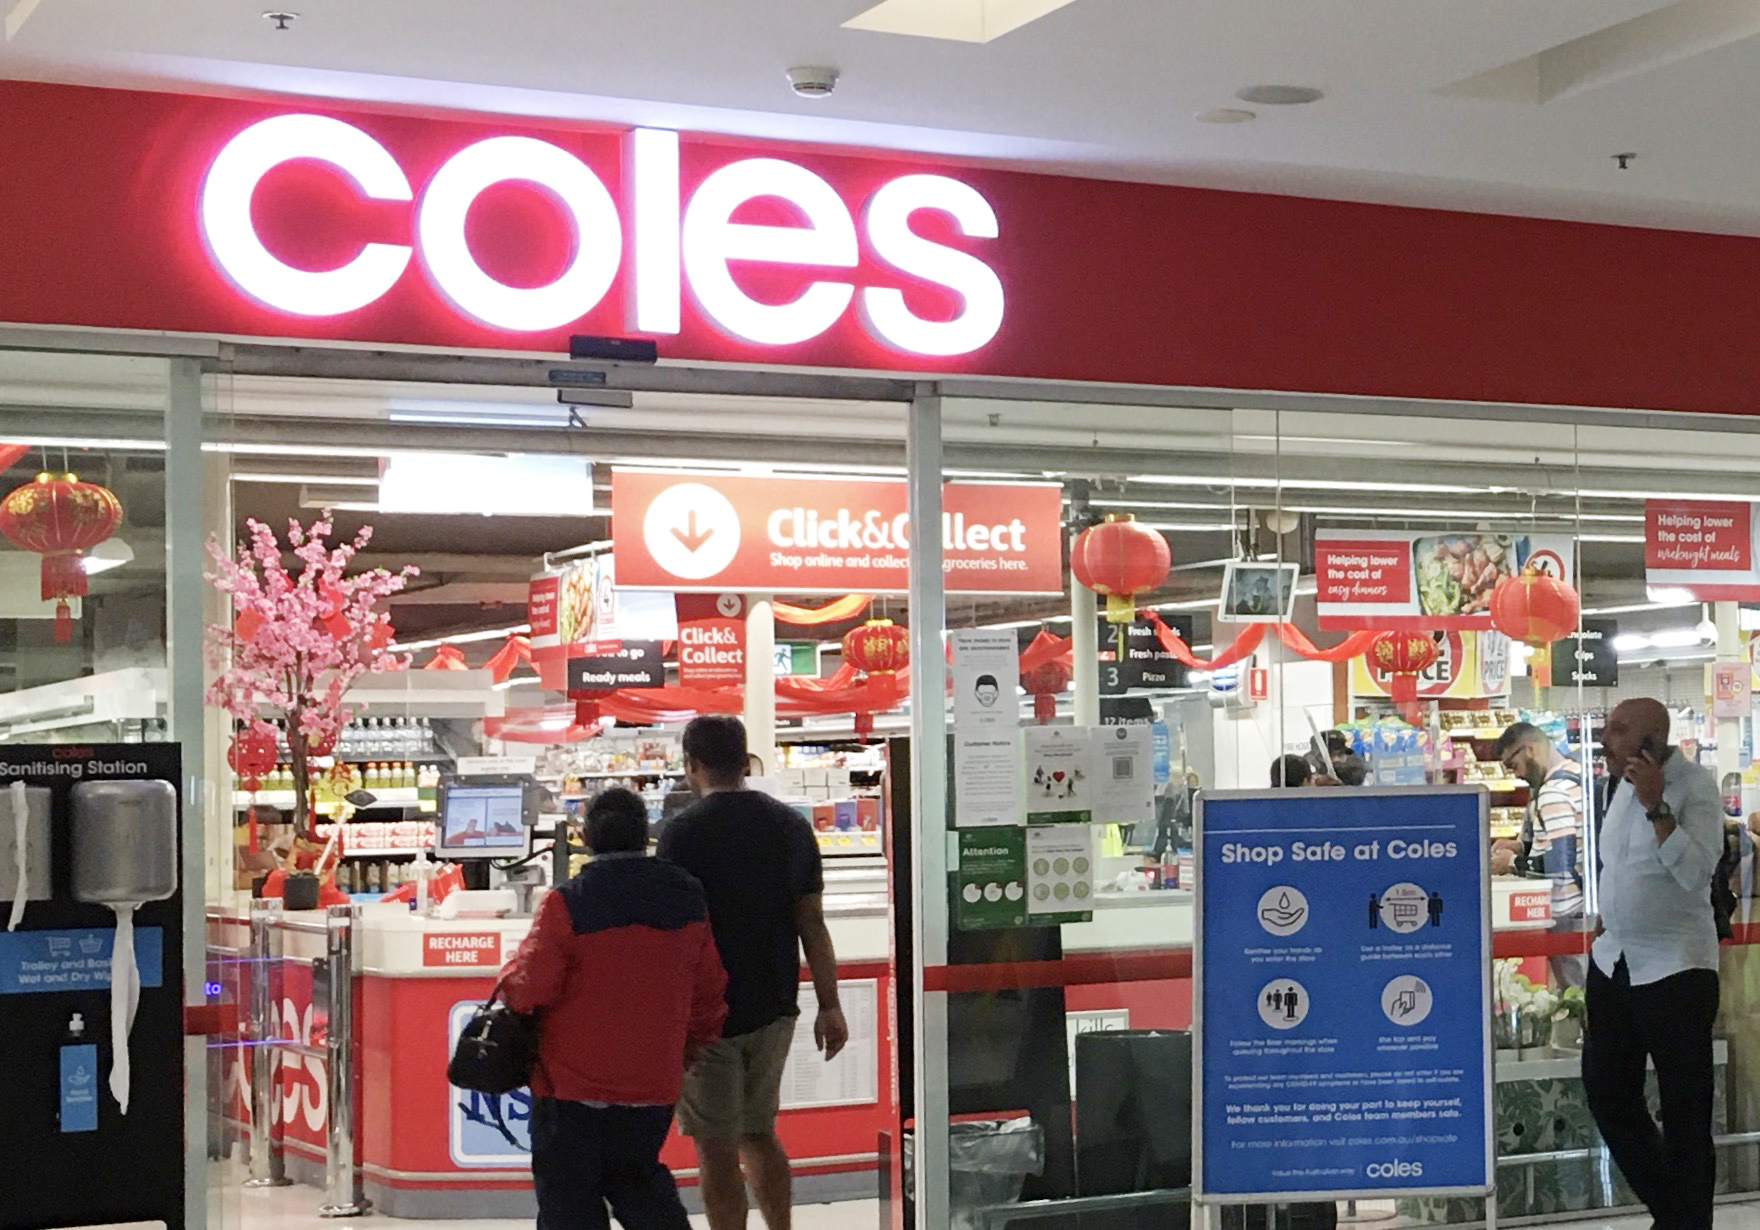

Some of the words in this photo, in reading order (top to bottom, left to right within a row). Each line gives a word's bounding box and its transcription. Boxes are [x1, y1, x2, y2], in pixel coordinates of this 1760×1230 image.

[202, 113, 1005, 356] coles
[767, 507, 1026, 551] Click&Cllect
[1657, 514, 1701, 530] Helping
[1704, 515, 1734, 527] lower
[1658, 530, 1676, 542] the
[1679, 531, 1702, 542] cost
[1705, 531, 1716, 543] of
[1327, 554, 1368, 568] Helping
[1370, 555, 1398, 565] lower
[1710, 545, 1740, 562] meals
[770, 553, 802, 570] Shop
[805, 553, 840, 568] online
[846, 554, 870, 568] and
[872, 554, 910, 569] collect
[945, 557, 997, 572] groceries
[1000, 557, 1028, 570] here.
[1327, 569, 1344, 579] the
[1347, 570, 1369, 579] cost
[1371, 569, 1382, 579] of
[681, 627, 738, 644] Click&
[1107, 625, 1118, 643] 2
[1128, 626, 1151, 636] Fresh
[630, 648, 644, 660] go
[682, 646, 743, 664] Collect
[1130, 649, 1153, 658] Fresh
[582, 671, 615, 685] Ready
[618, 670, 650, 683] meals
[1107, 667, 1119, 686] 3
[0, 761, 83, 778] Sanitising
[87, 760, 147, 774] Station
[963, 847, 1009, 856] Attention
[1221, 843, 1284, 866] Shop
[1291, 842, 1345, 861] Safe
[1354, 840, 1380, 860] at
[1387, 839, 1457, 859] Coles
[429, 936, 494, 949] RECHARGE
[445, 950, 478, 963] HERE
[21, 961, 57, 971] Trolley
[61, 959, 84, 969] and
[18, 974, 41, 984] Wet
[44, 972, 68, 983] and
[71, 972, 90, 983] Dry
[1366, 1158, 1423, 1178] coles
